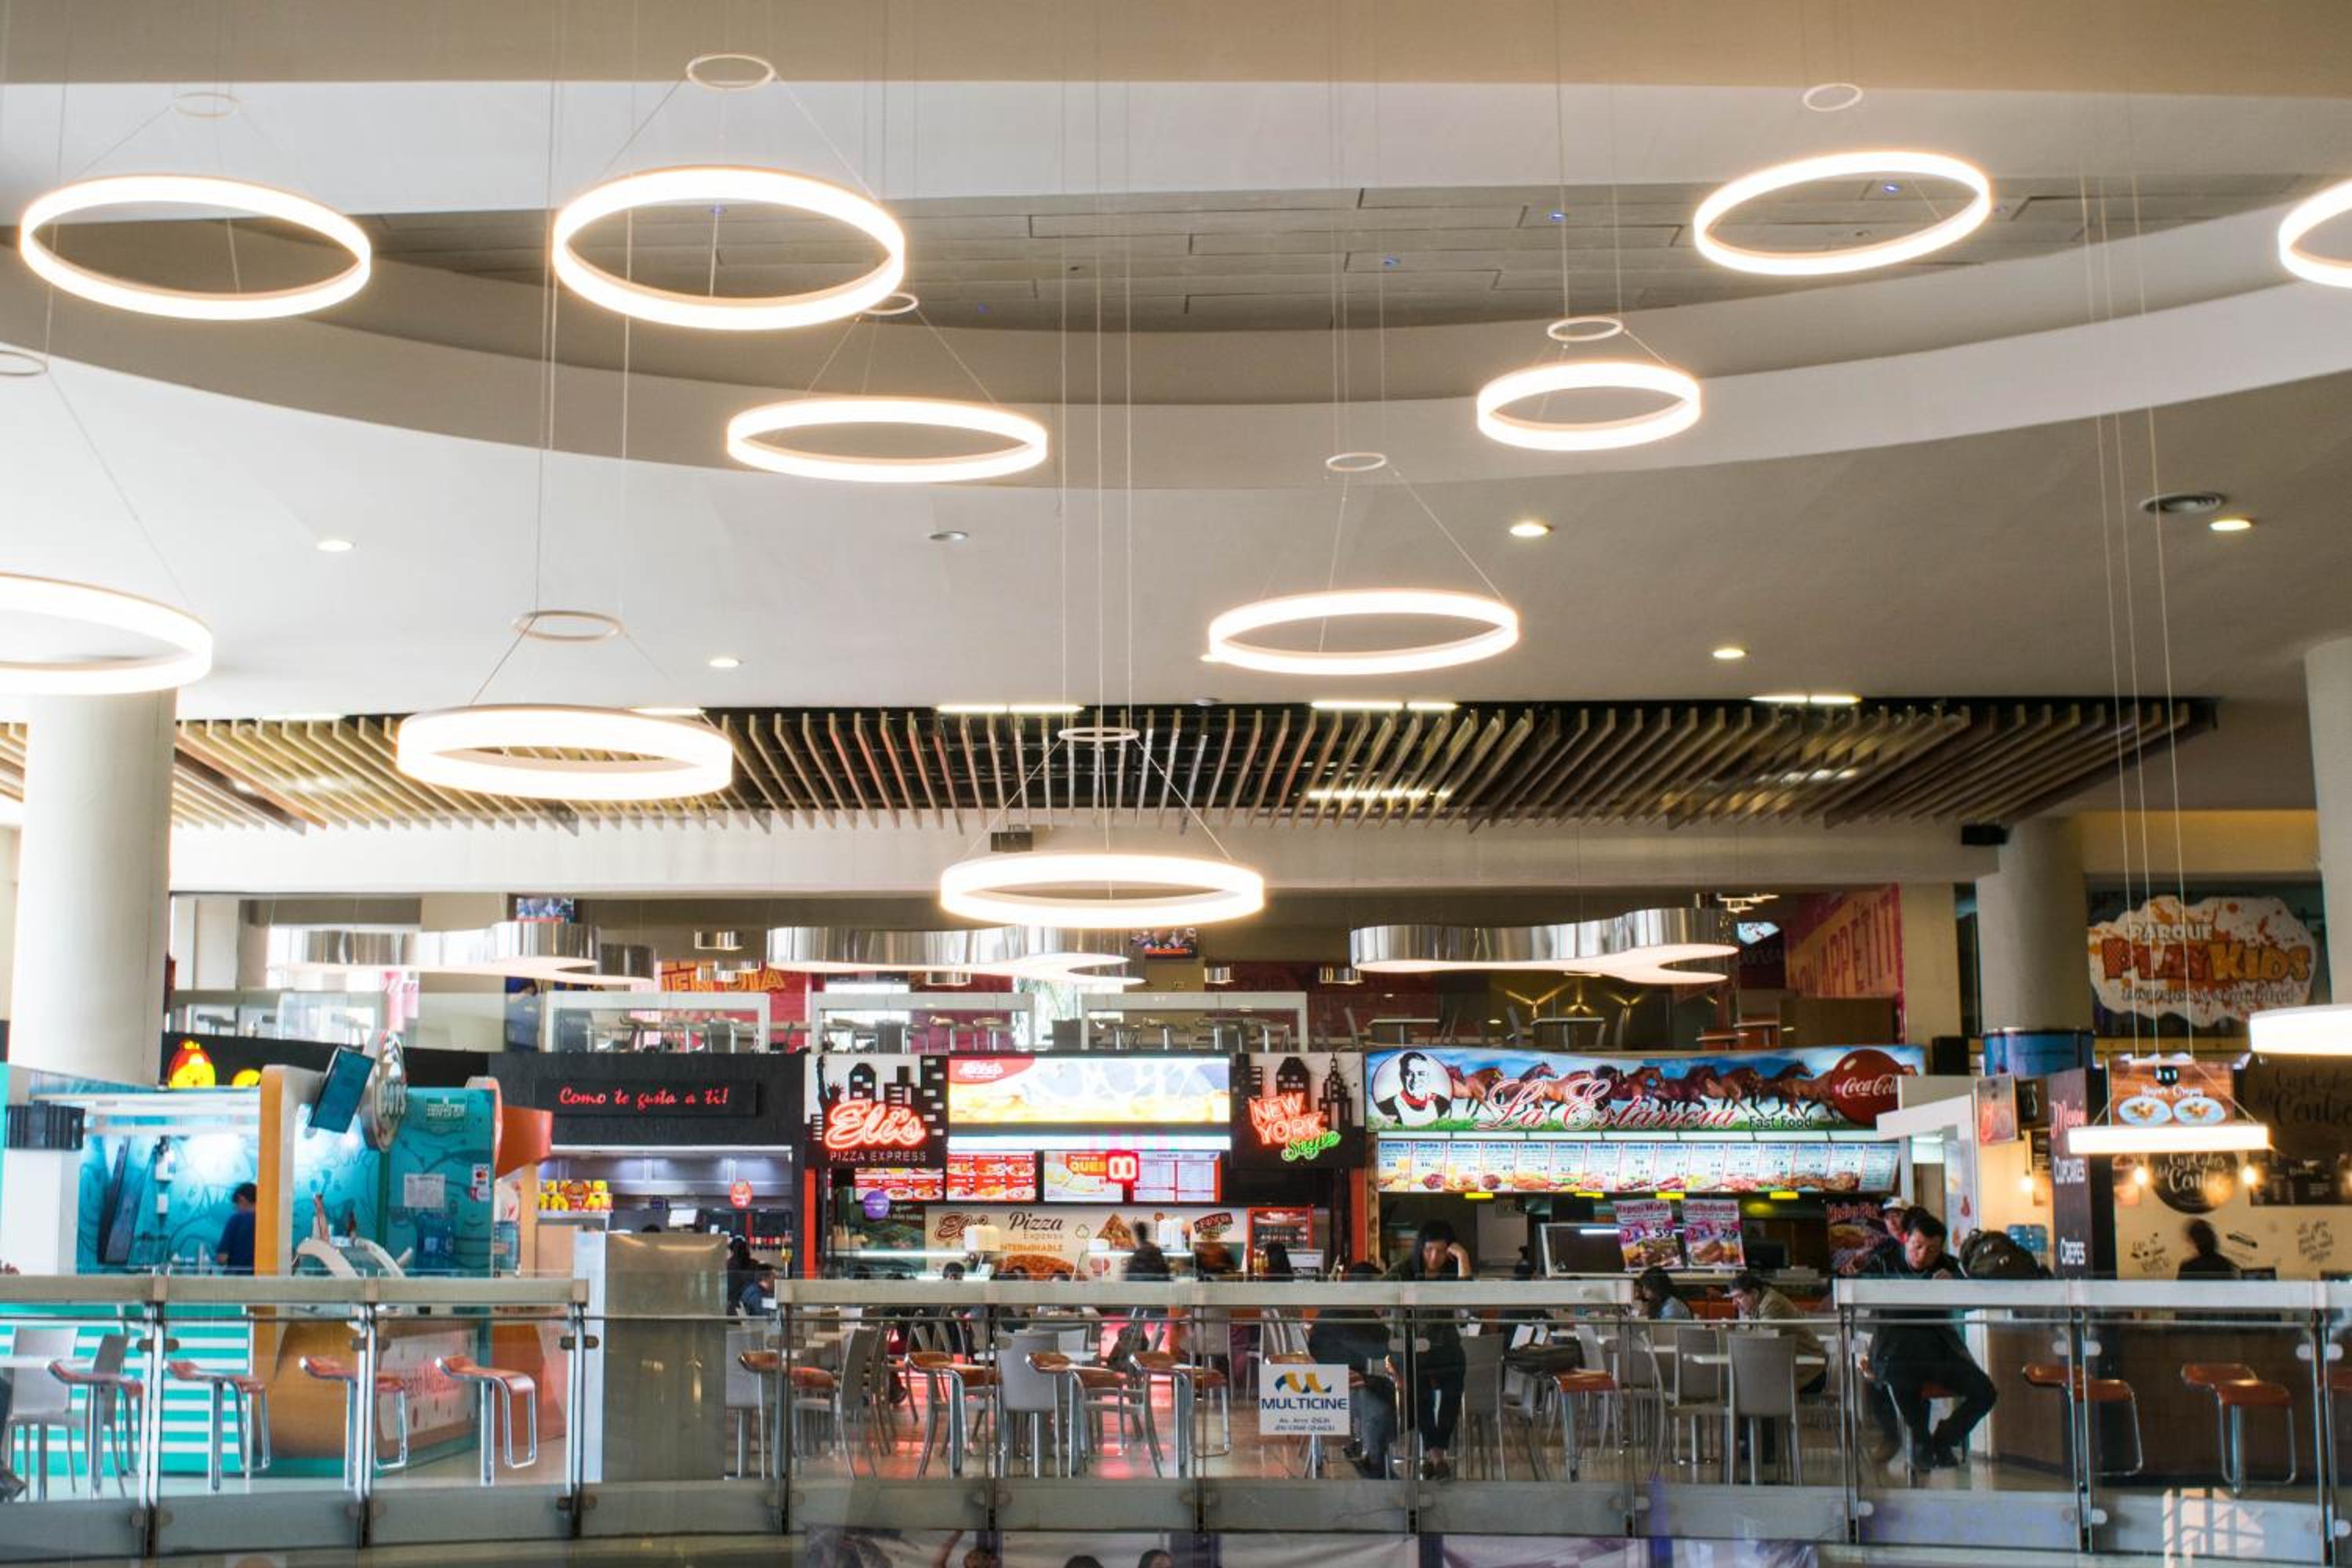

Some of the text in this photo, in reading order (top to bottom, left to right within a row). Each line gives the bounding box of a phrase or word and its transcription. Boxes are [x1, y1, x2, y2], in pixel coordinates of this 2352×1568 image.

[559, 1086, 729, 1110] Como te gusta a ti!
[1249, 1092, 1305, 1123] NEW
[1474, 1078, 1737, 1130] La Estancia
[1254, 1111, 1324, 1145] YORK
[1748, 1116, 1813, 1129] Fast Food
[829, 1151, 927, 1161] PIZZA EXPRESS
[1281, 1130, 1341, 1161] Style
[1009, 1211, 1063, 1230] Pizza
[1261, 1398, 1348, 1410] MULTICINE
